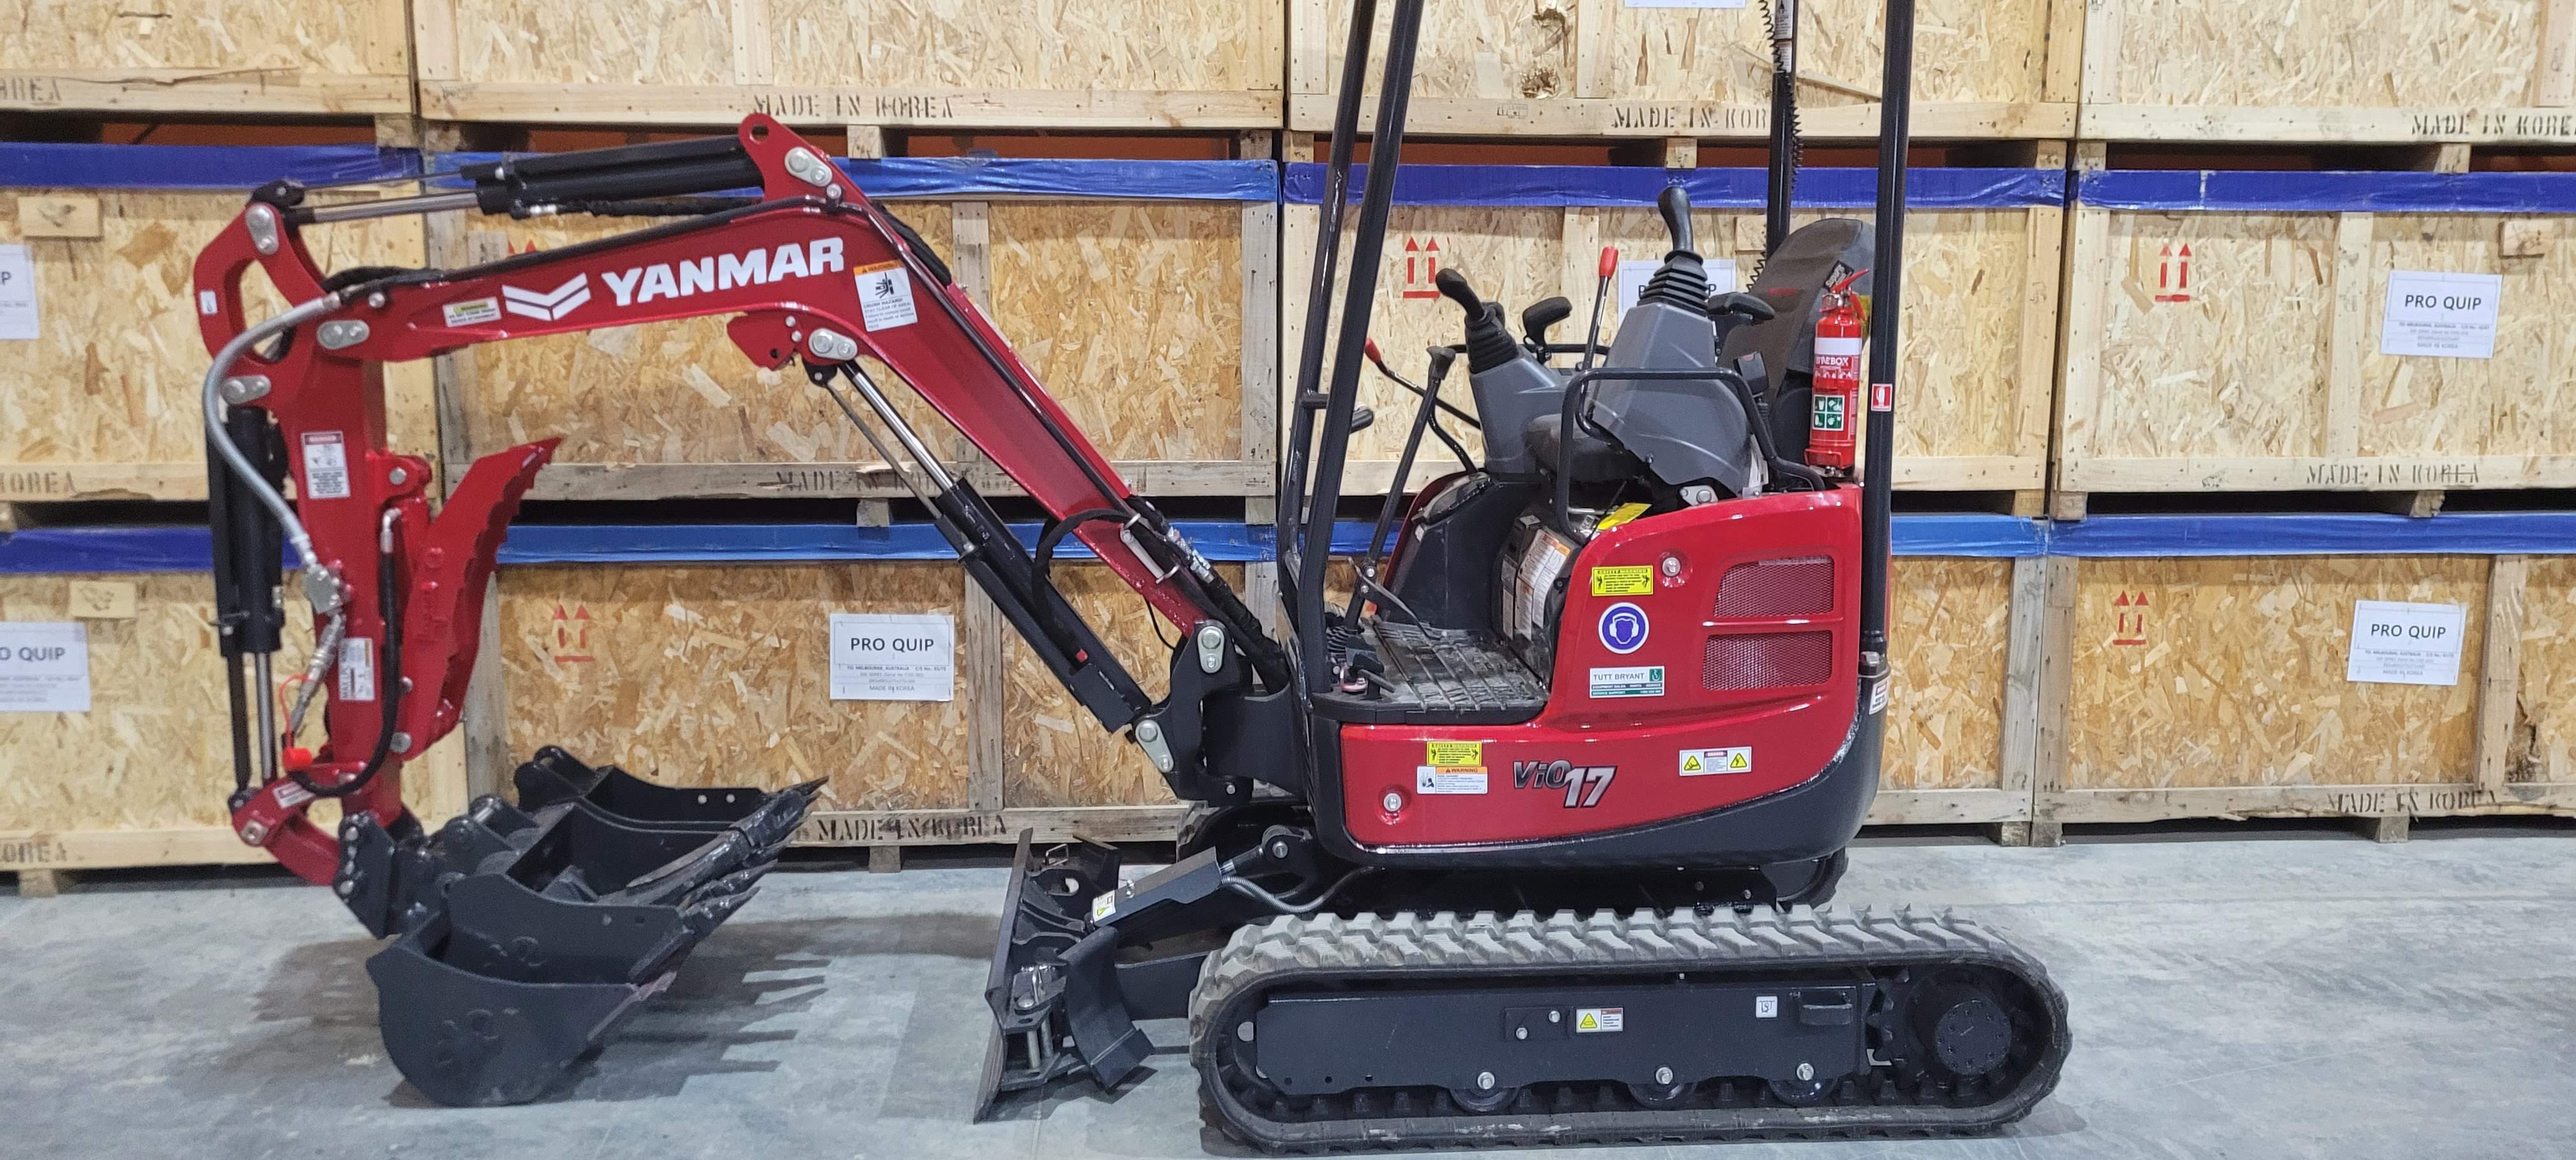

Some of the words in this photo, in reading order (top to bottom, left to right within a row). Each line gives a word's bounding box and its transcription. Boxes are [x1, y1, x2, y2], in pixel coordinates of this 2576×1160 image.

[753, 95, 820, 117] MADE
[836, 95, 861, 117] IN
[875, 95, 953, 118] KOREA
[1613, 107, 1675, 128] MADE
[1689, 107, 1715, 128] IN
[2411, 114, 2471, 135] MADE
[2482, 114, 2506, 135] IN
[2517, 114, 2576, 136] KORE
[601, 236, 844, 307] YANMAR
[2405, 294, 2437, 309] PRO
[2443, 296, 2482, 311] QUIP
[2307, 464, 2364, 484] MADE
[2378, 464, 2400, 484] IN
[2412, 463, 2480, 484] KOREA
[2371, 623, 2403, 637] PRO
[2408, 625, 2447, 639] QUIP
[19, 646, 66, 662] QUIP
[850, 637, 885, 652] PRO
[892, 638, 935, 653] QUIP
[2327, 792, 2385, 813] MADE
[817, 818, 883, 841] MADE
